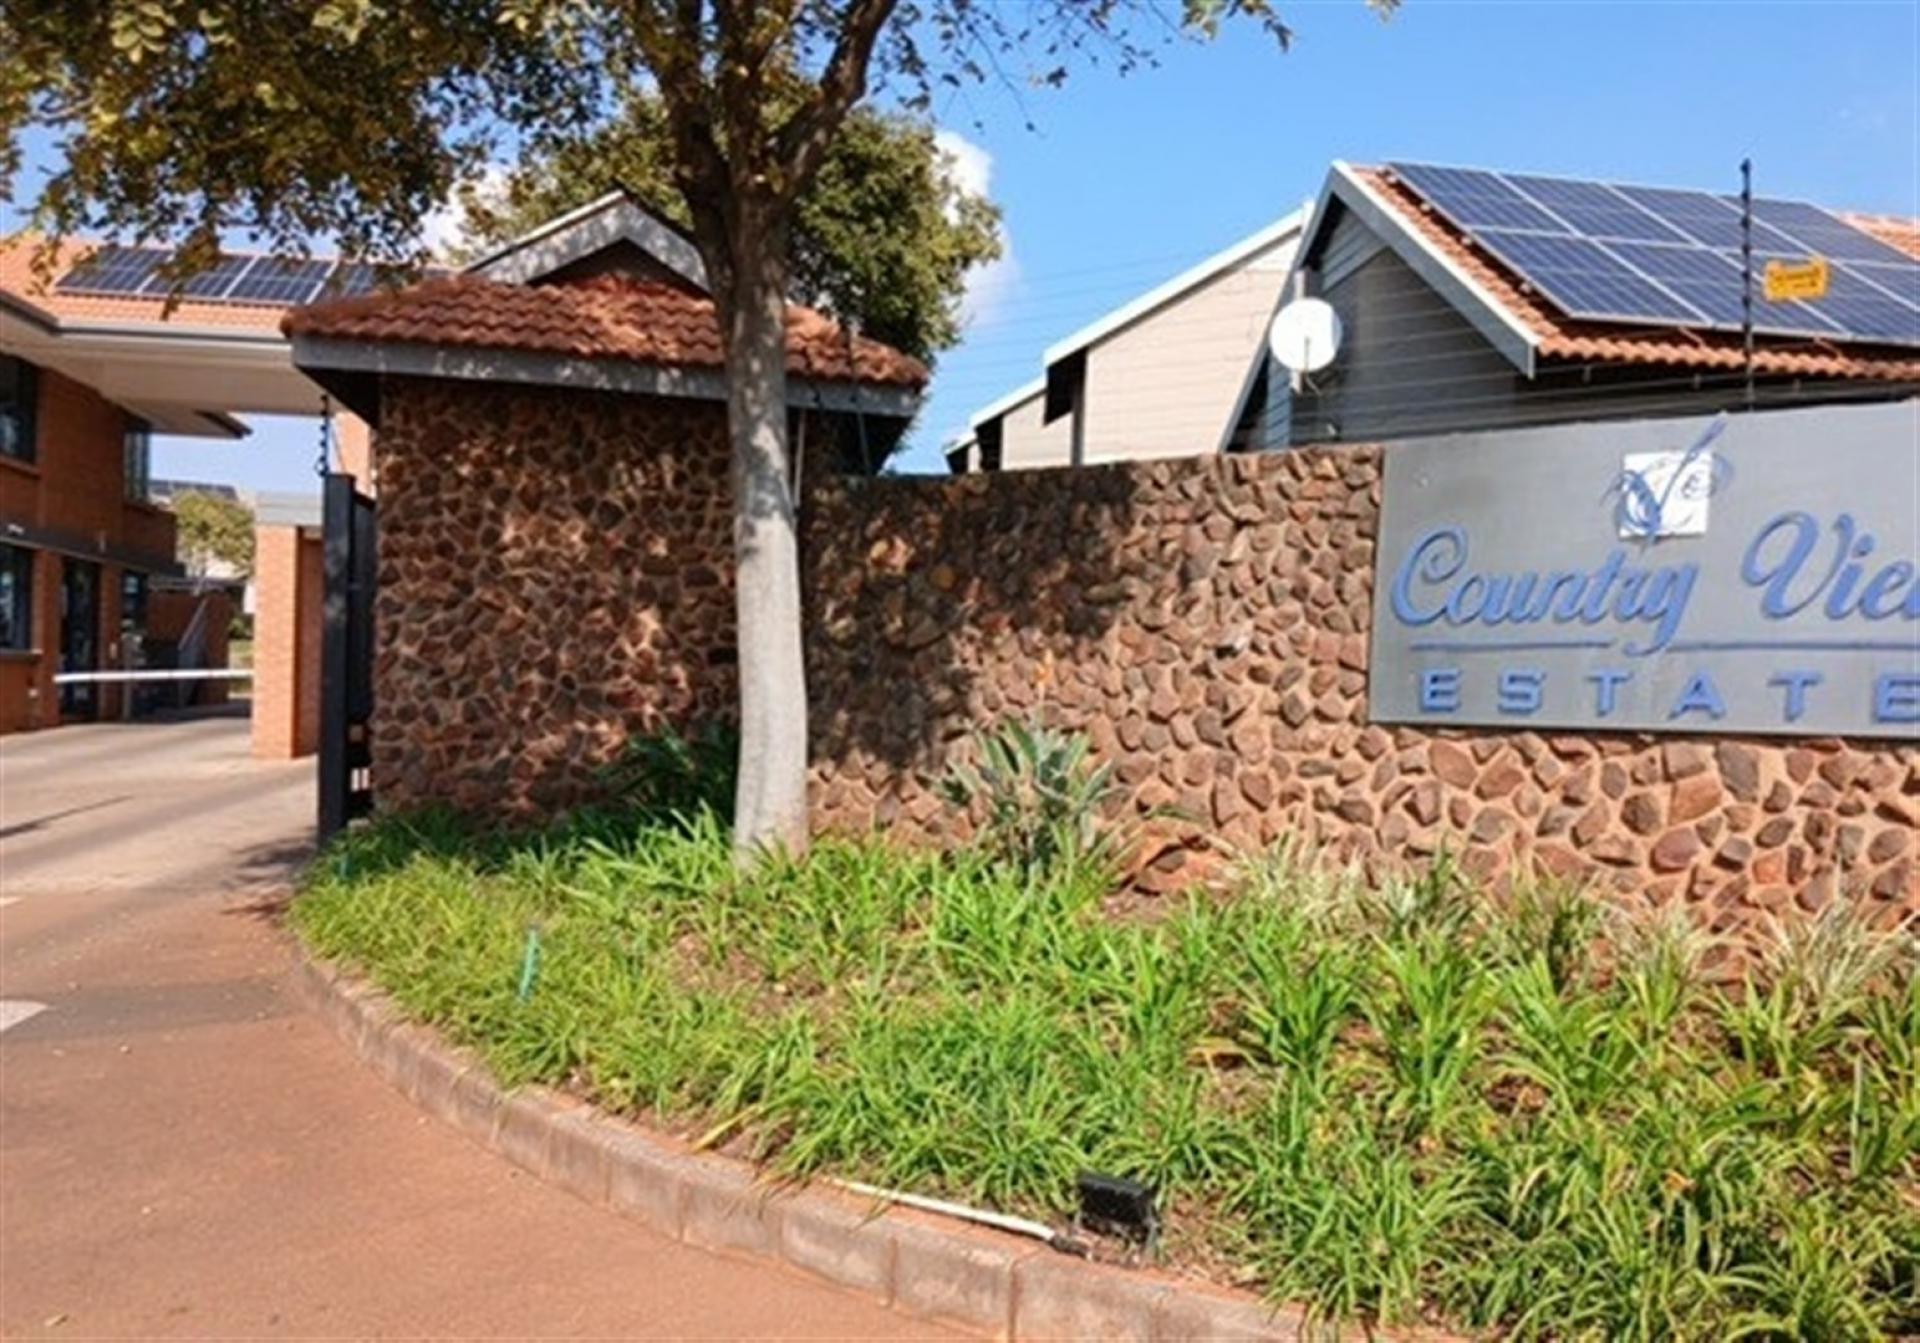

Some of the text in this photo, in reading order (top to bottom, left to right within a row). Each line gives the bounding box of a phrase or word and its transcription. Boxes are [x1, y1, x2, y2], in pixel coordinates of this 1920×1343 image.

[1392, 511, 1920, 657] Country Vie
[1419, 668, 1920, 723] ESTATE
